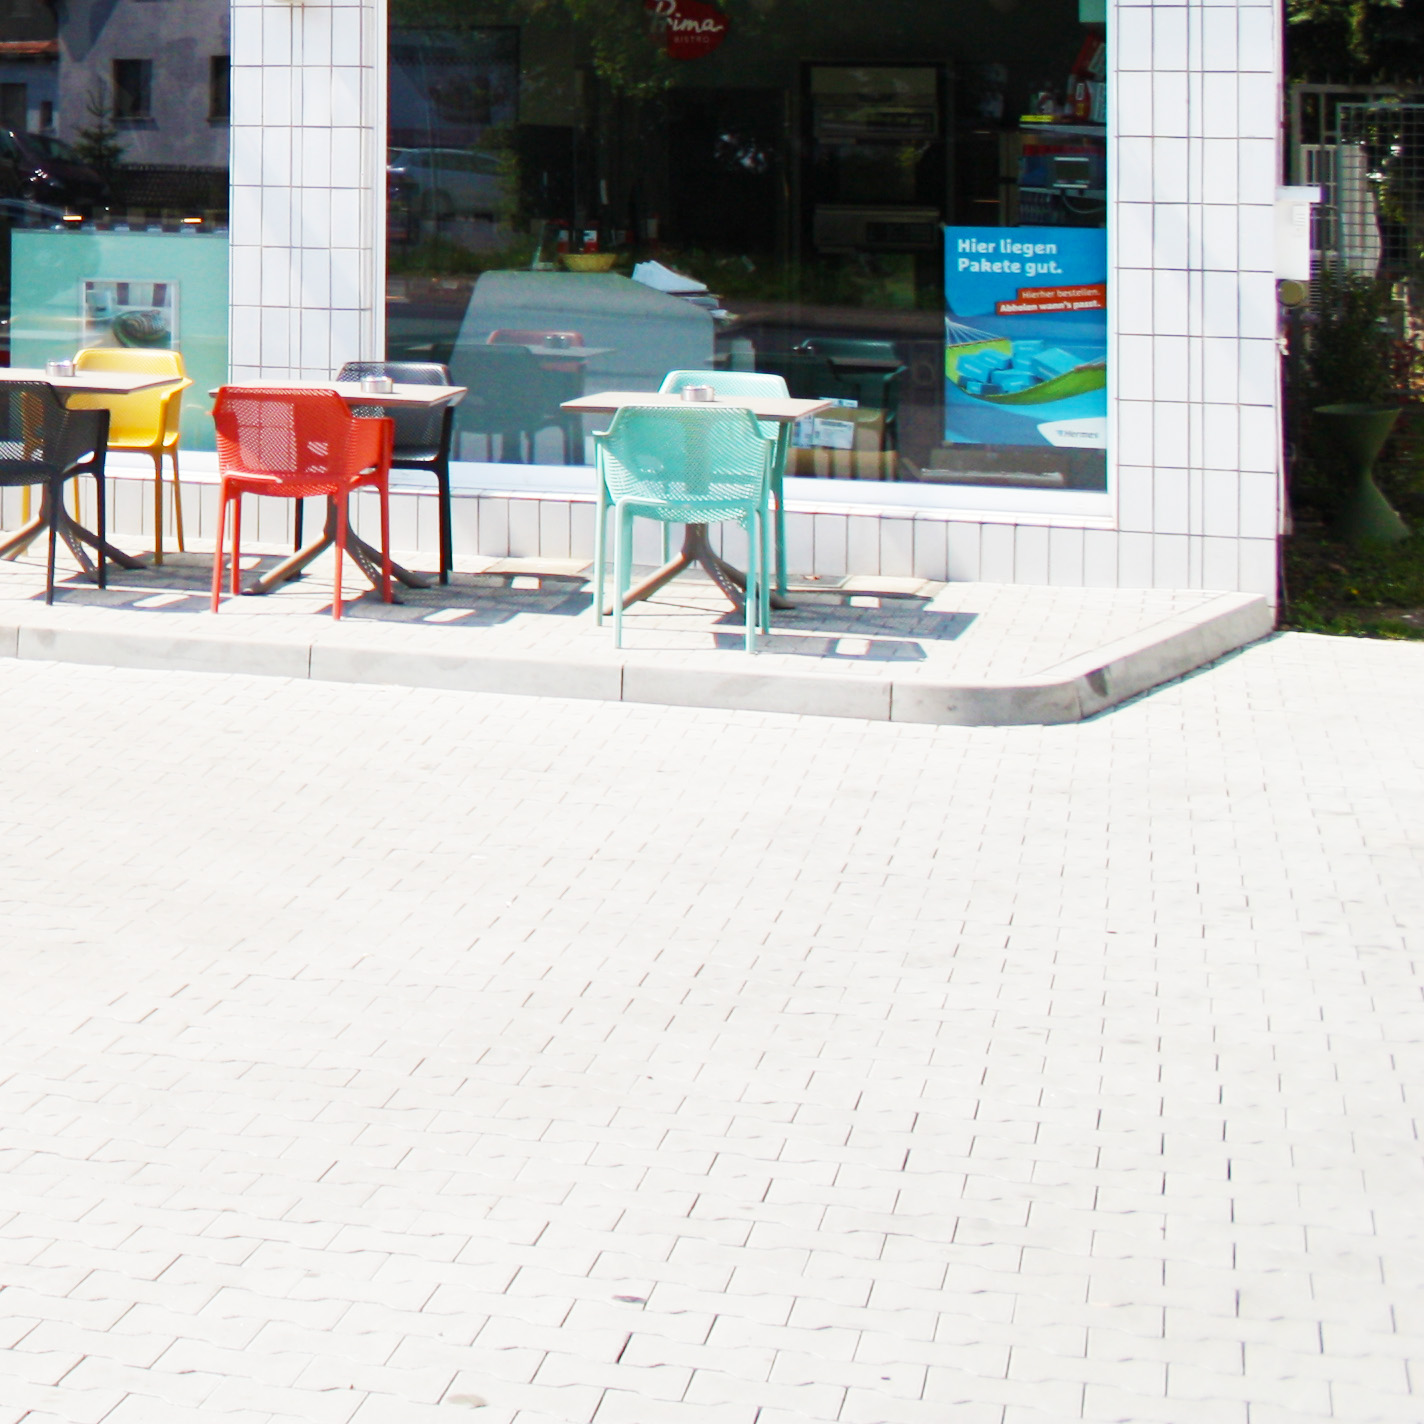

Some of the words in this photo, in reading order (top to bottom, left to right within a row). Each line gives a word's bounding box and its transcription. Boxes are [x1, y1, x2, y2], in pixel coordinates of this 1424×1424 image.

[957, 238, 996, 254] Hier
[1000, 239, 1058, 257] liegen
[957, 258, 1022, 273] Pakete
[1025, 260, 1064, 277] gut.
[1022, 289, 1055, 299] Hierher
